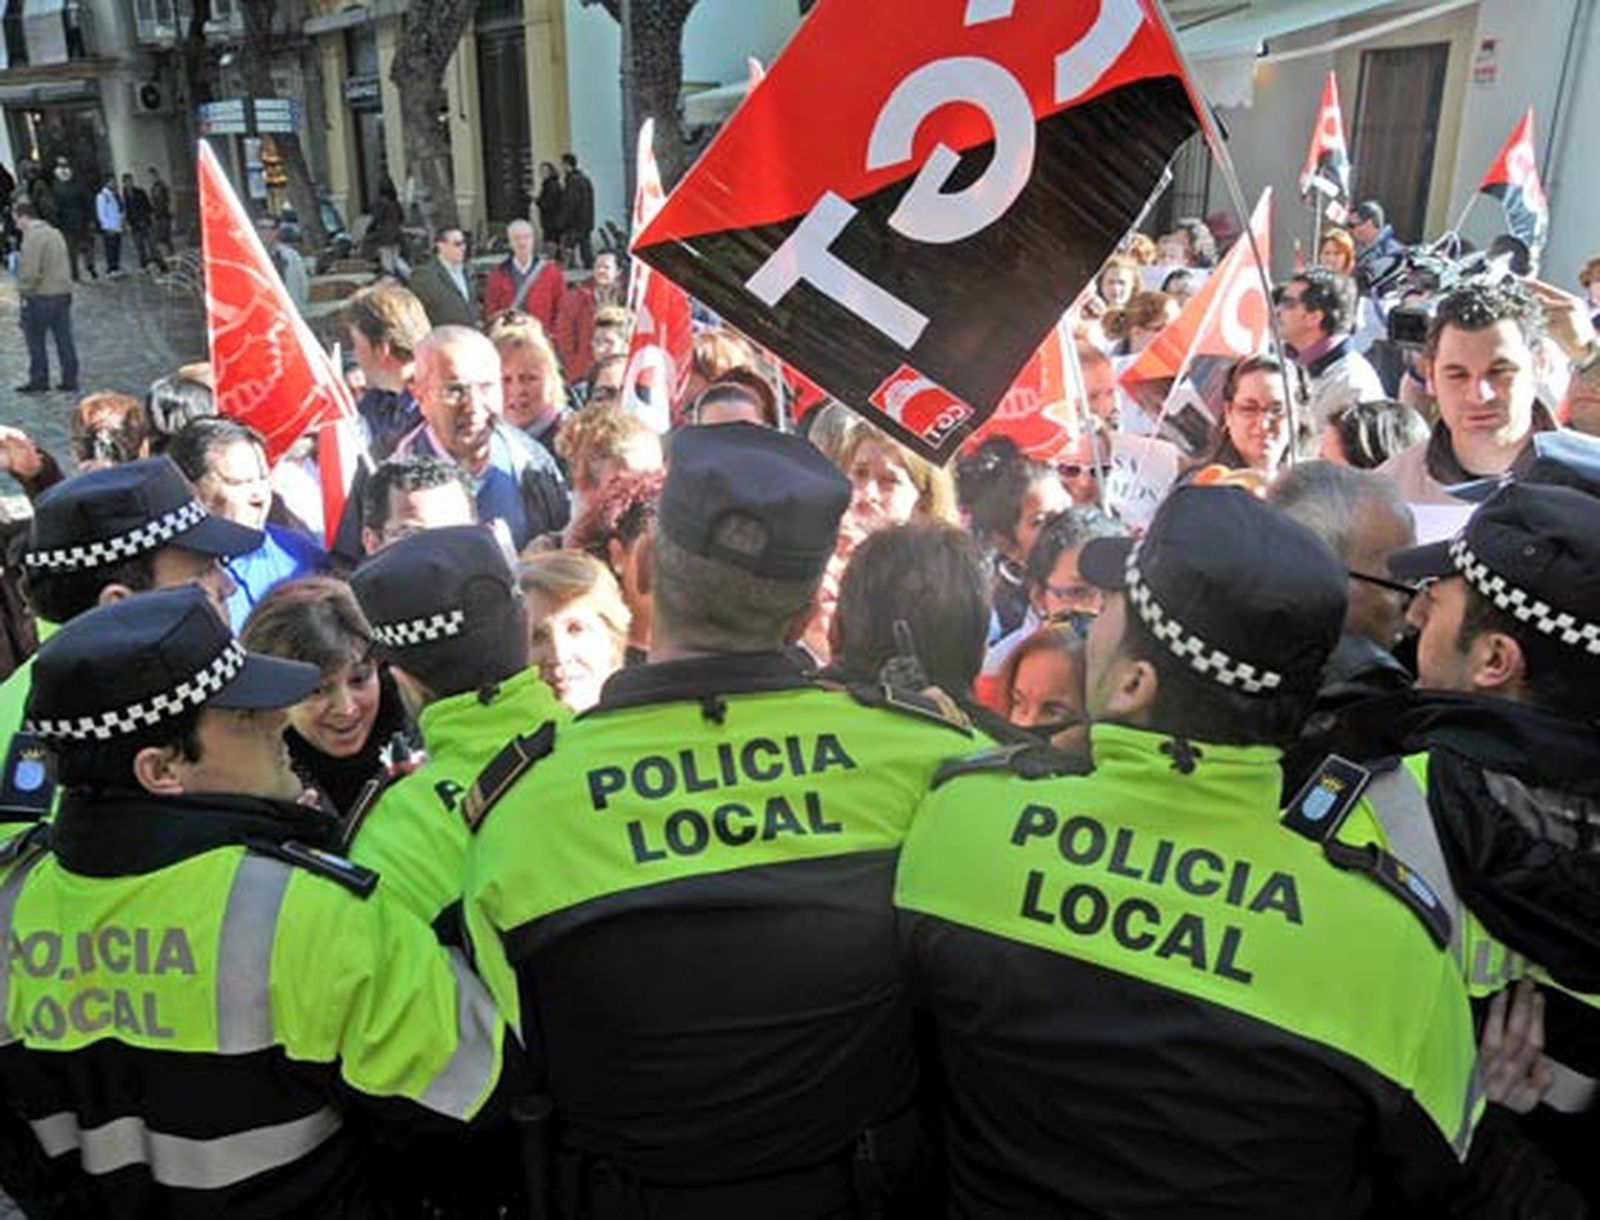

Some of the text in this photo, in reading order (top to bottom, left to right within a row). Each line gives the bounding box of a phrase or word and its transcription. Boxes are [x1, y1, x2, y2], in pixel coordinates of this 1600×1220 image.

[588, 732, 857, 812] POLICIA
[627, 791, 843, 864] LOCAL
[1010, 803, 1304, 926] POLICIA
[1020, 870, 1254, 985] LOCAL
[23, 986, 175, 1040] OCAL
